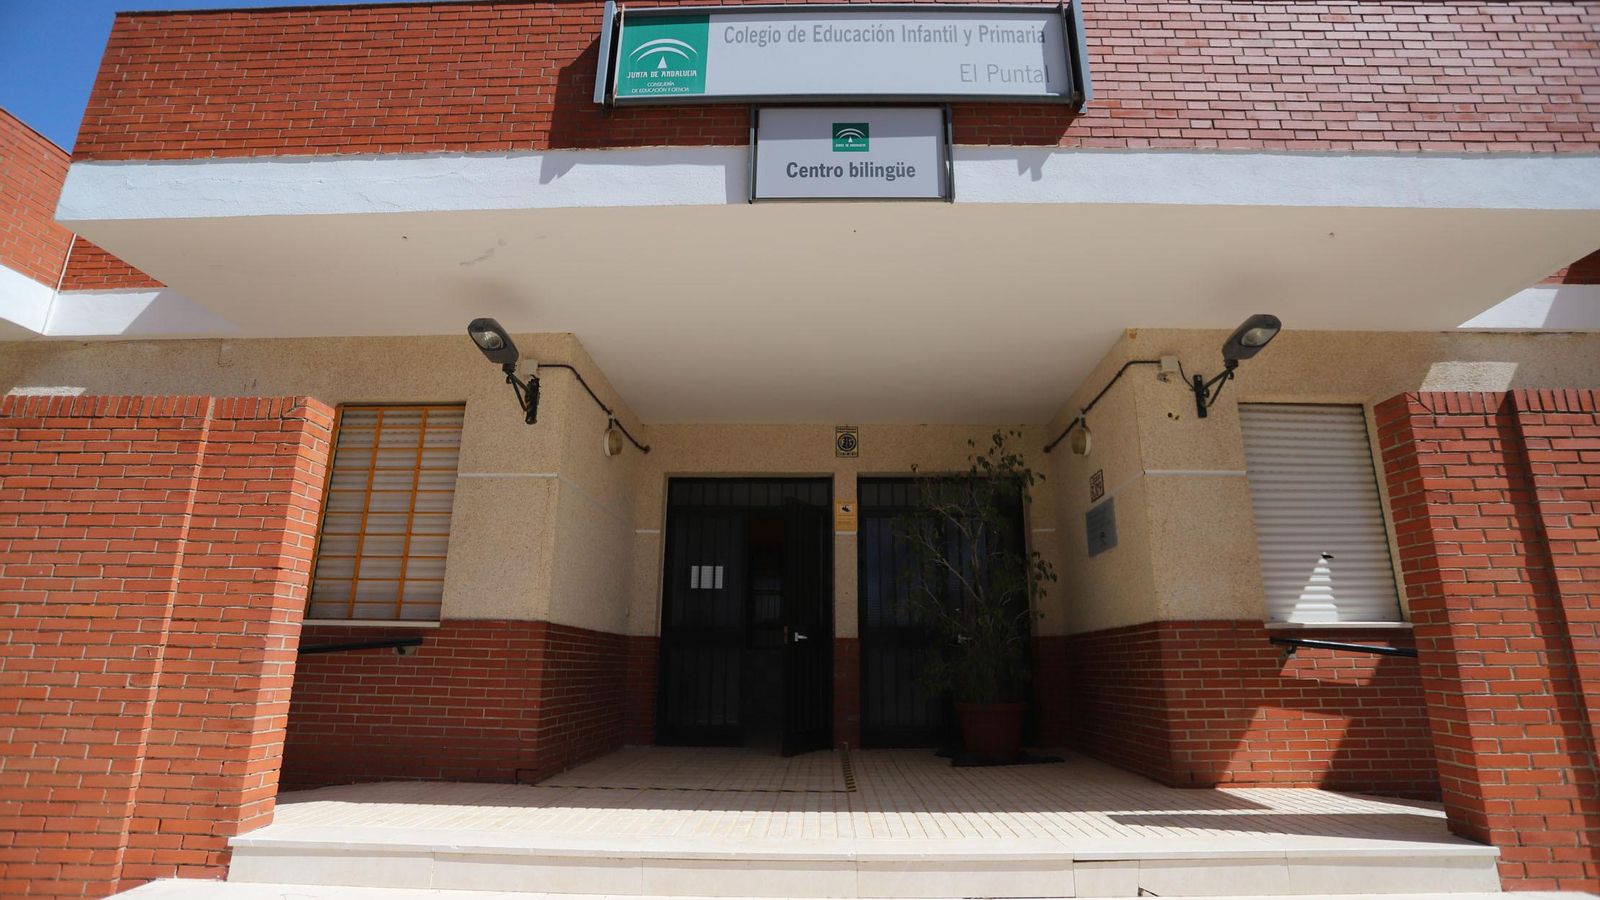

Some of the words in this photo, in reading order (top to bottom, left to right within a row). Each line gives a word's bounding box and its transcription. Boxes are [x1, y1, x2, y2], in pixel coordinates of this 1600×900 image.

[724, 25, 781, 47] Colegio
[787, 25, 806, 42] de
[813, 24, 895, 43] Educación
[902, 24, 958, 43] Infantil
[963, 29, 972, 47] y
[979, 25, 1046, 44] Primaria
[627, 71, 648, 79] JUNTA
[960, 63, 977, 83] El
[987, 63, 1050, 83] Puntal
[786, 161, 844, 178] Centro
[849, 161, 916, 181] bilingüe
